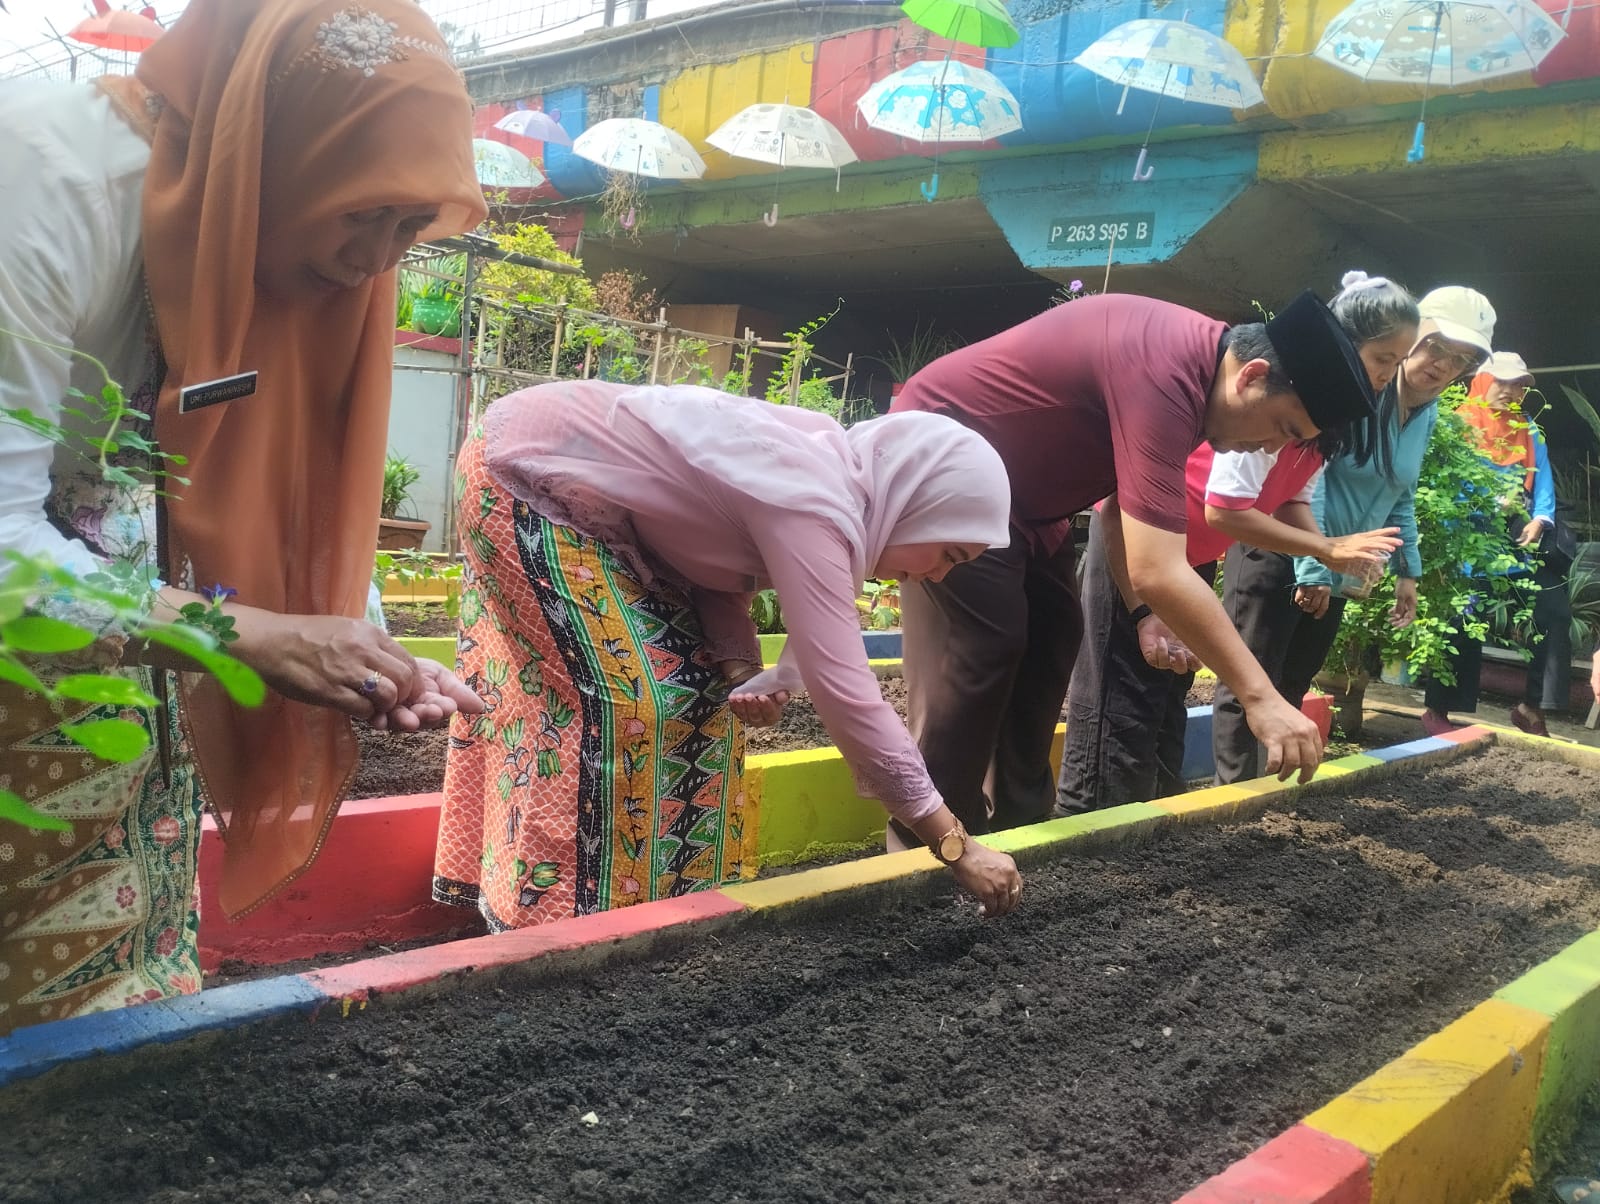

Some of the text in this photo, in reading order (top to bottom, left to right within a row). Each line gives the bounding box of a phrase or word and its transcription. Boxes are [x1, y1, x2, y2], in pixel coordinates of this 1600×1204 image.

[1051, 226, 1062, 242] P
[1066, 224, 1096, 242] 263
[1136, 222, 1148, 240] B
